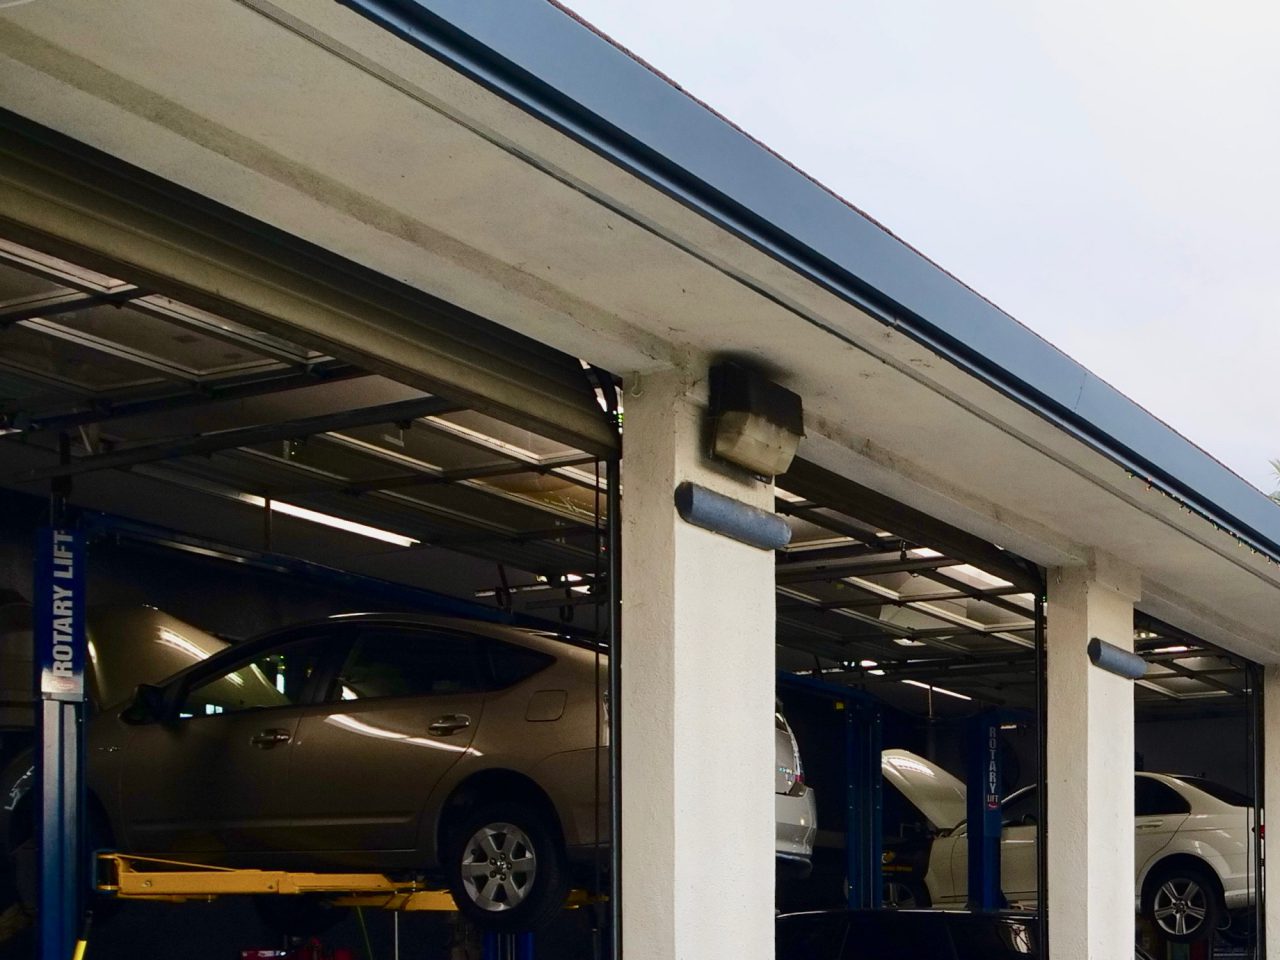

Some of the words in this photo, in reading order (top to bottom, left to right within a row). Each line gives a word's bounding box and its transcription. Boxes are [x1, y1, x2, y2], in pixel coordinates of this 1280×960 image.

[53, 529, 74, 579] LIFT
[52, 585, 74, 678] ROTARY
[988, 726, 997, 794] ROTARY
